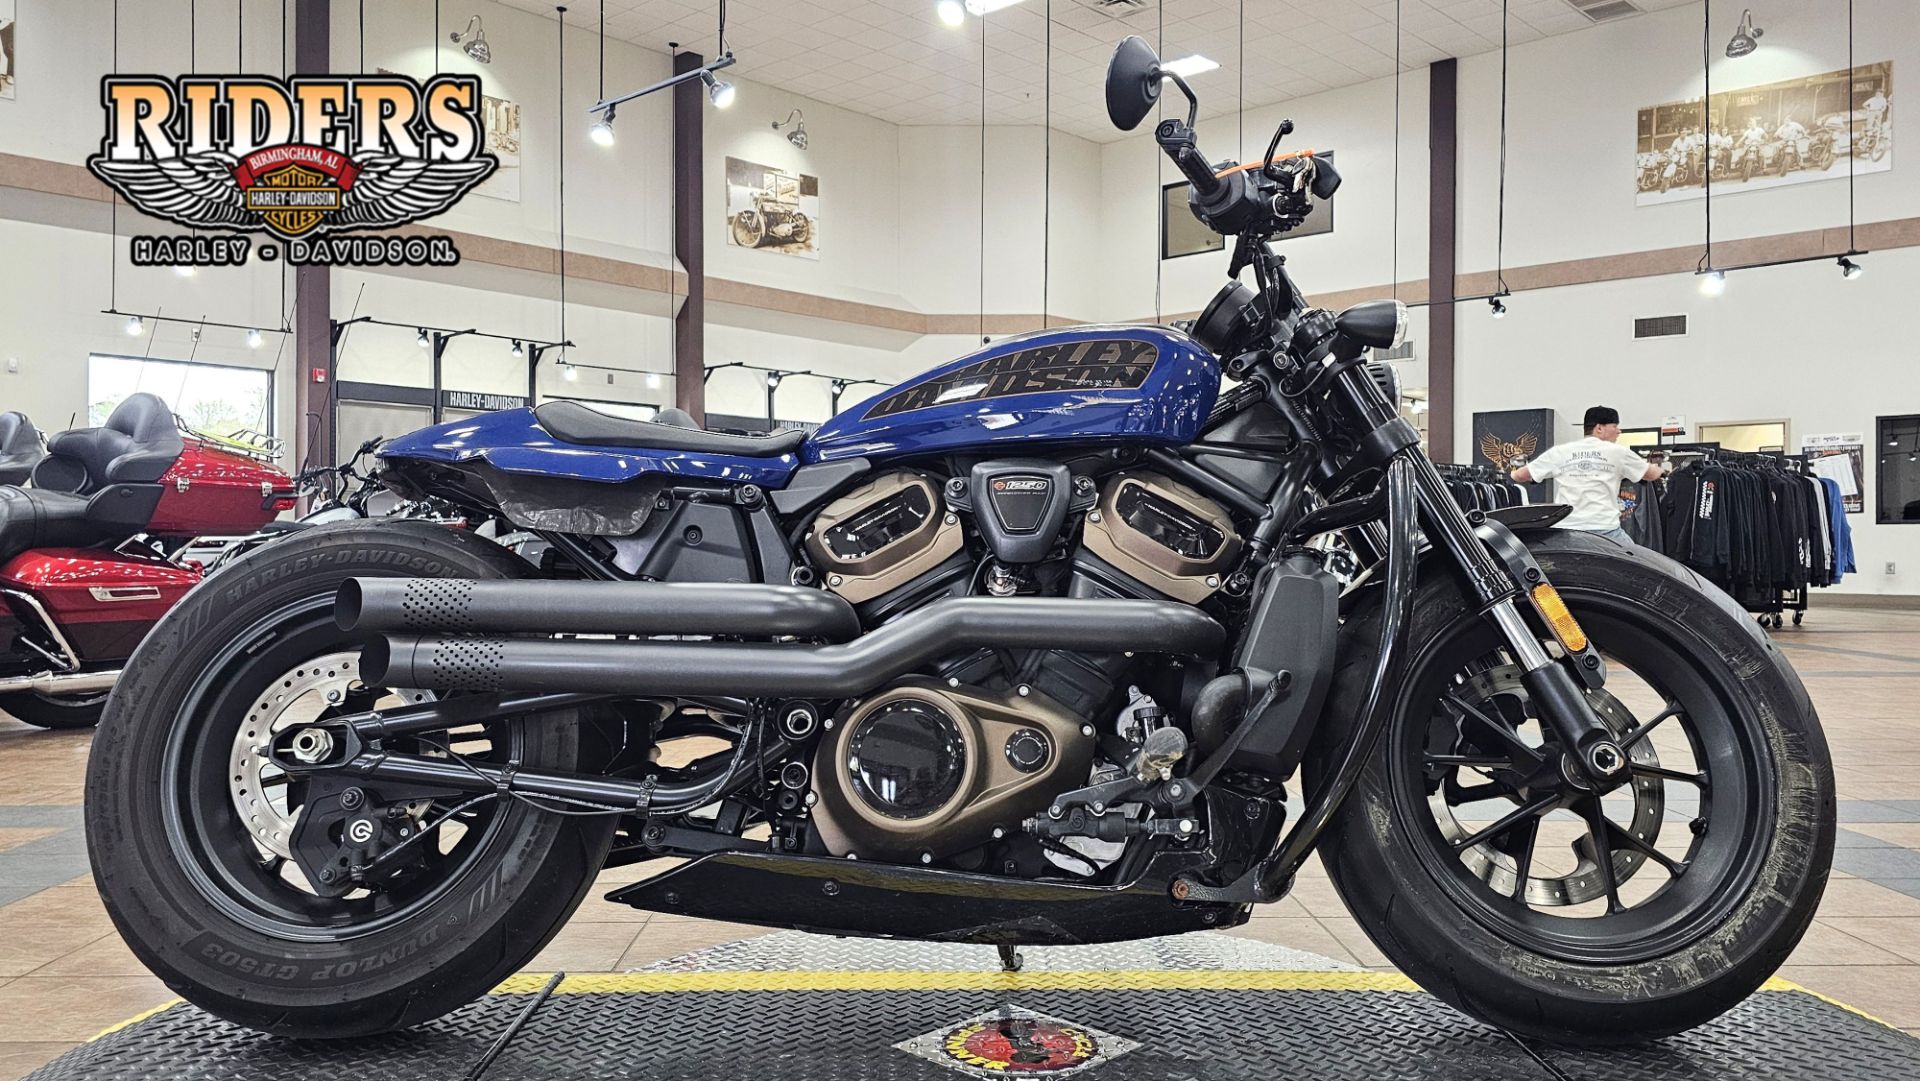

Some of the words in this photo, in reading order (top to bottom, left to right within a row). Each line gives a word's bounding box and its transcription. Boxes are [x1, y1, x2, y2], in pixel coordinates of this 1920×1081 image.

[449, 391, 524, 410] HARLEY-DAVIDSON
[1004, 481, 1048, 491] 1250
[199, 942, 300, 982] GT503
[310, 924, 441, 982] DUNLOP
